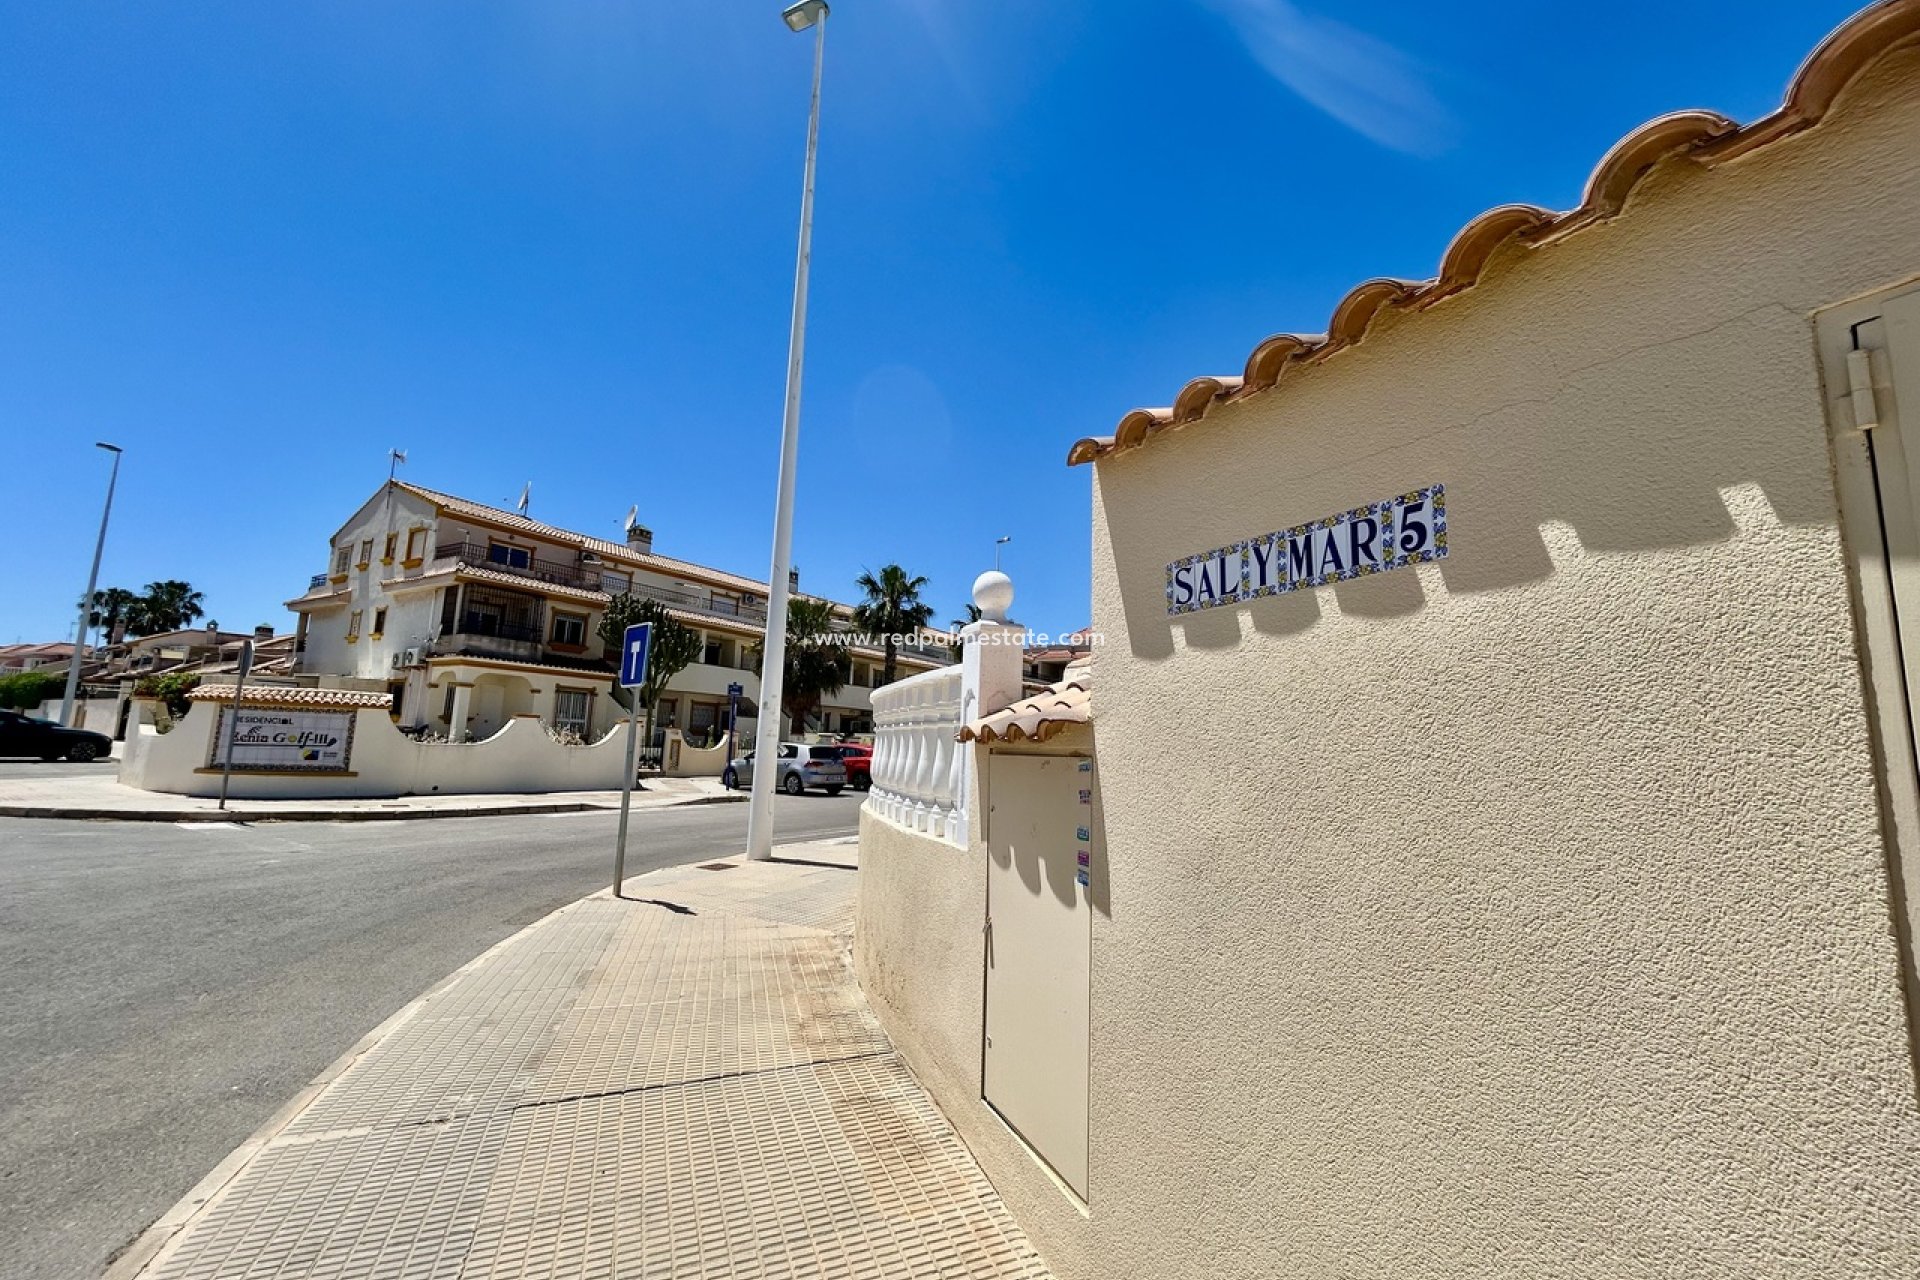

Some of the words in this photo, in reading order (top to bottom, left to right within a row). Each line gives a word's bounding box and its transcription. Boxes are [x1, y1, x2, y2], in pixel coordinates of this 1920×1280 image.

[1174, 553, 1240, 606] SAL
[1252, 542, 1274, 587] Y
[1288, 517, 1378, 581] MAR
[1399, 500, 1428, 553] 5
